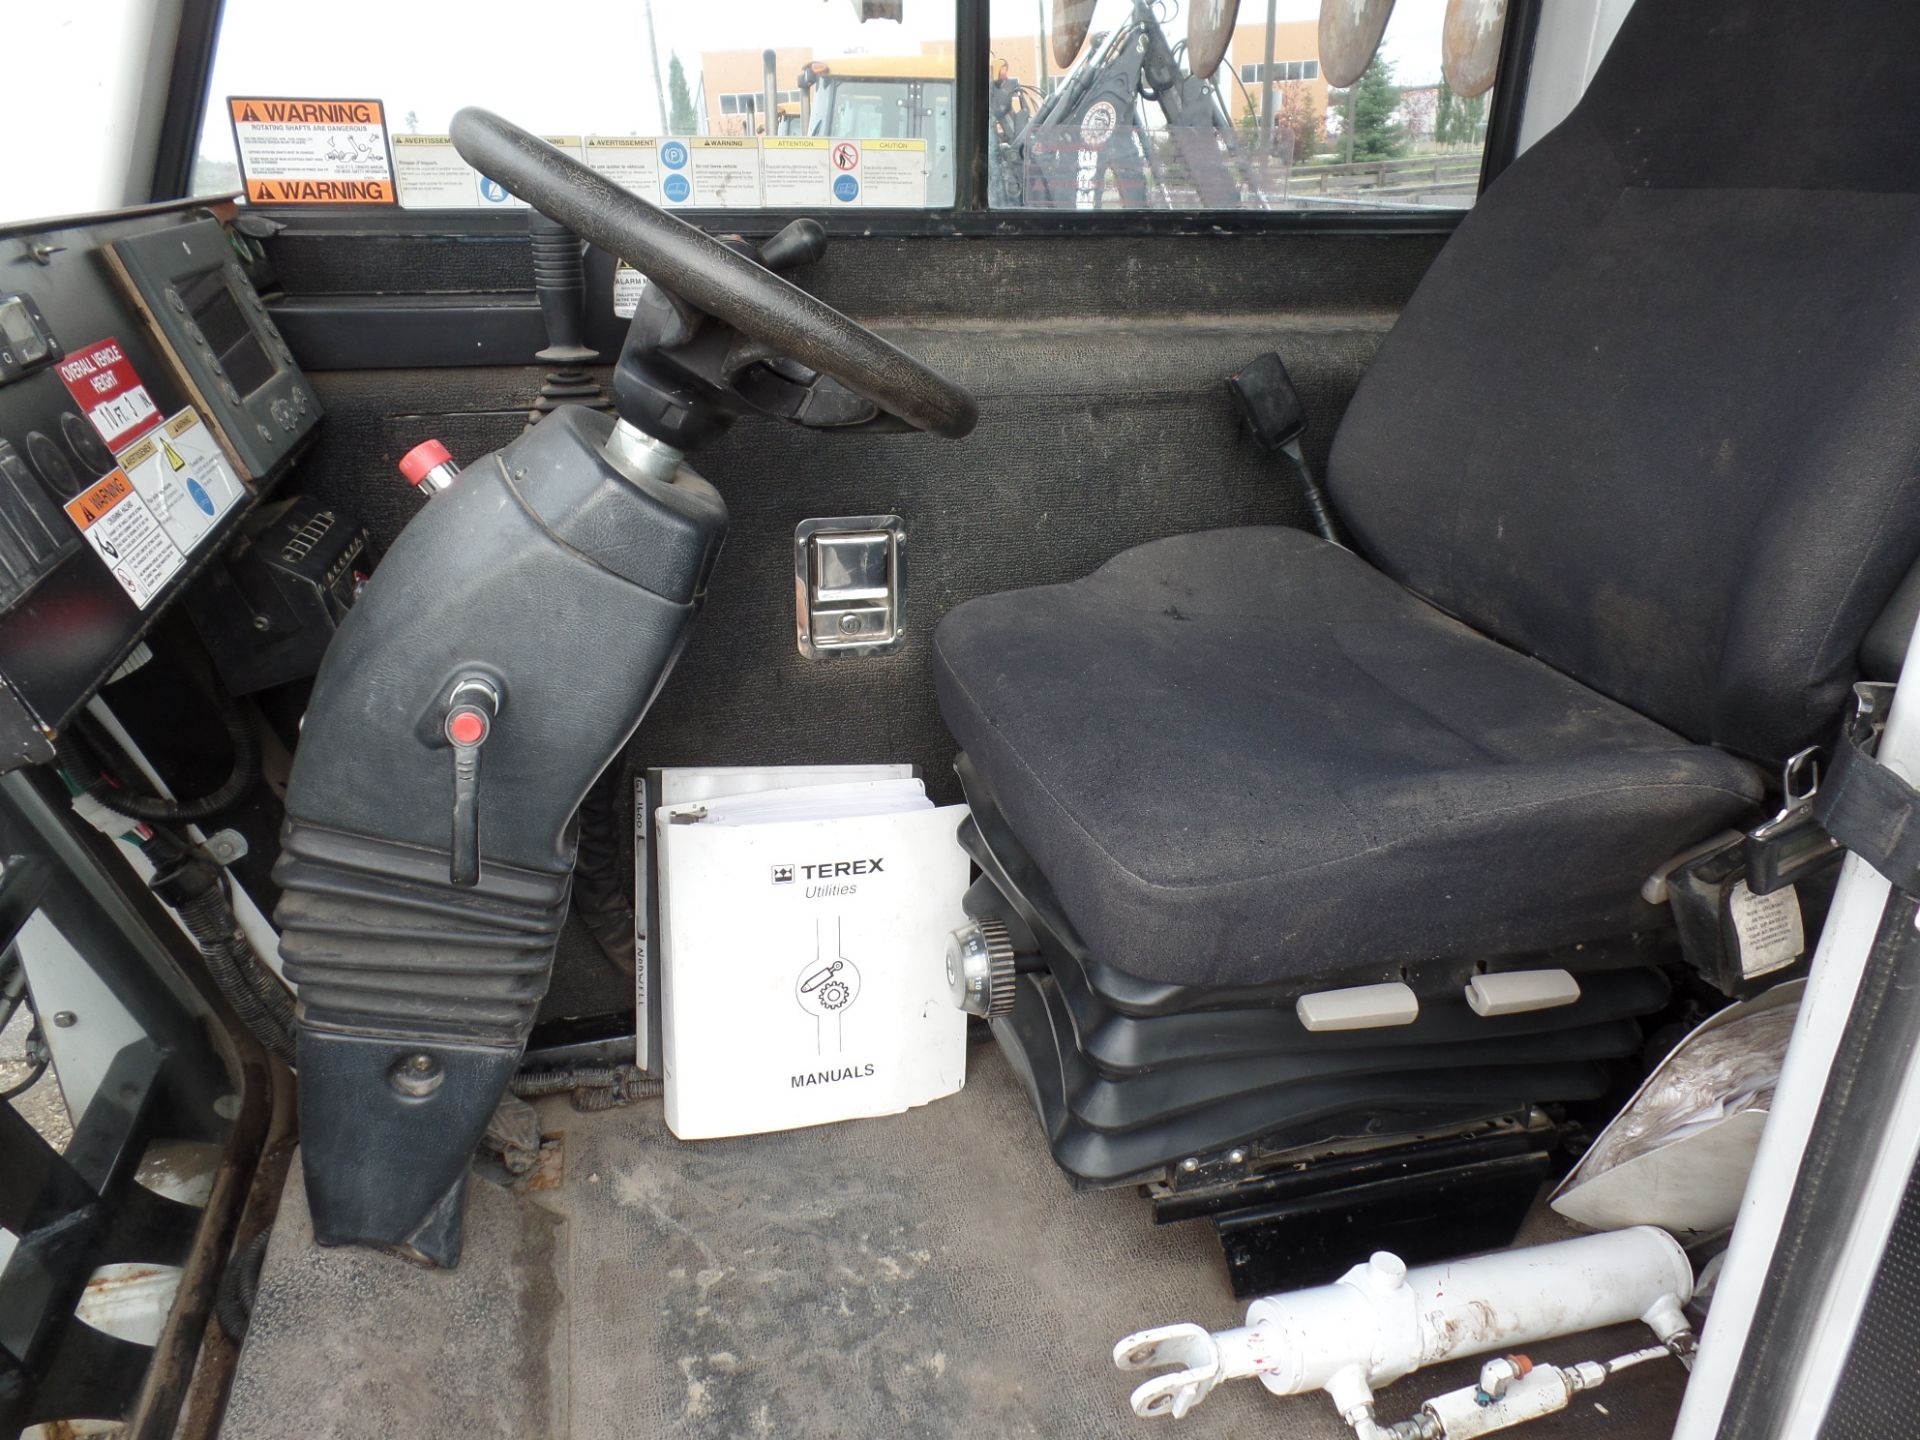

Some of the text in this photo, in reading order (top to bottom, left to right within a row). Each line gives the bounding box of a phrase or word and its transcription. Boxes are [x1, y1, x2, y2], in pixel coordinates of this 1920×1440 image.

[264, 103, 371, 123] WARNING
[285, 124, 312, 132] SHAFTS
[278, 181, 383, 200] WARNING
[61, 345, 122, 383] OVERALL VEHICLE
[89, 370, 118, 394] HEIGHT
[100, 405, 120, 430] 10
[124, 395, 138, 418] 3
[89, 477, 126, 511] WARNING
[800, 857, 885, 880] TEREX
[805, 883, 858, 899] Utilities
[974, 975, 983, 990] 110
[790, 1063, 875, 1089] MANUALS
